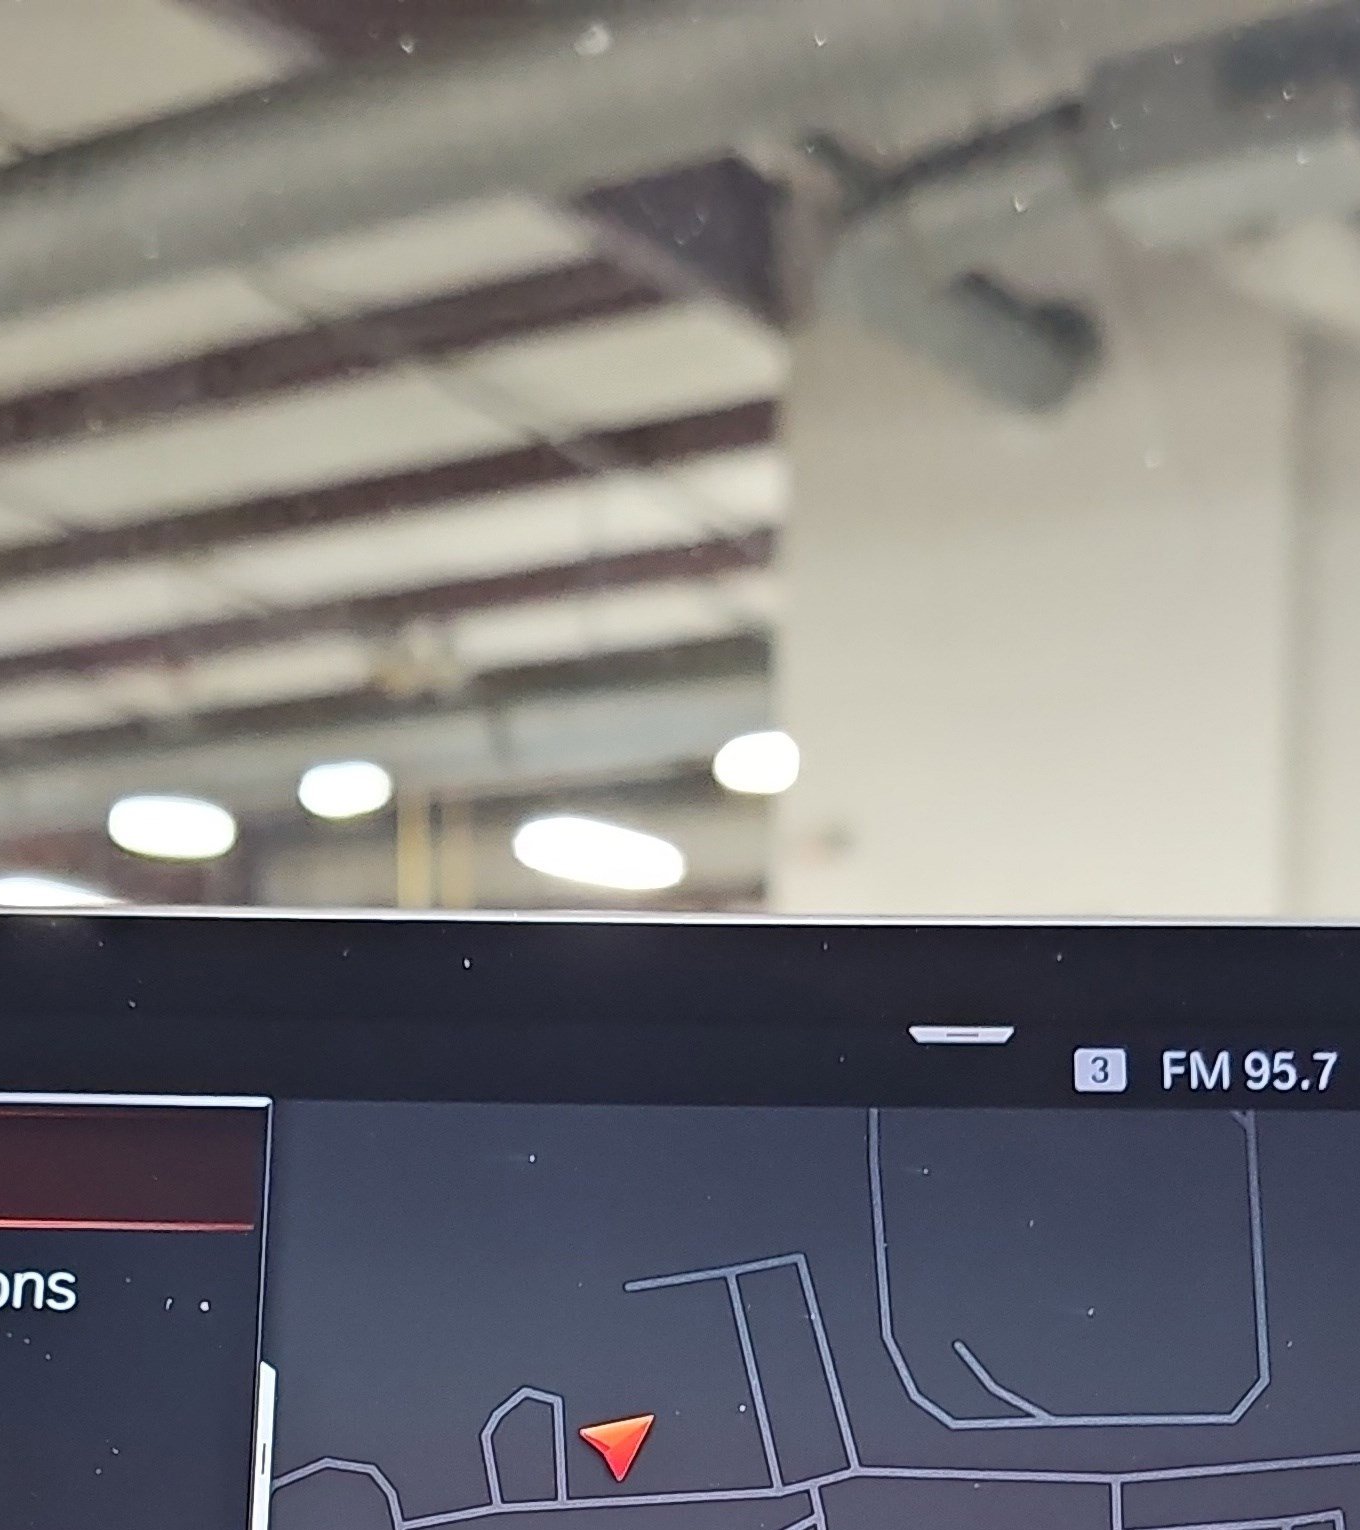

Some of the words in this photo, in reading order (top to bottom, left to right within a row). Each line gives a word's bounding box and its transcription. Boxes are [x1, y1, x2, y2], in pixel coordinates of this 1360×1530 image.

[1088, 1057, 1110, 1083] 3
[1161, 1052, 1230, 1090] FM
[1244, 1052, 1338, 1092] 95.7
